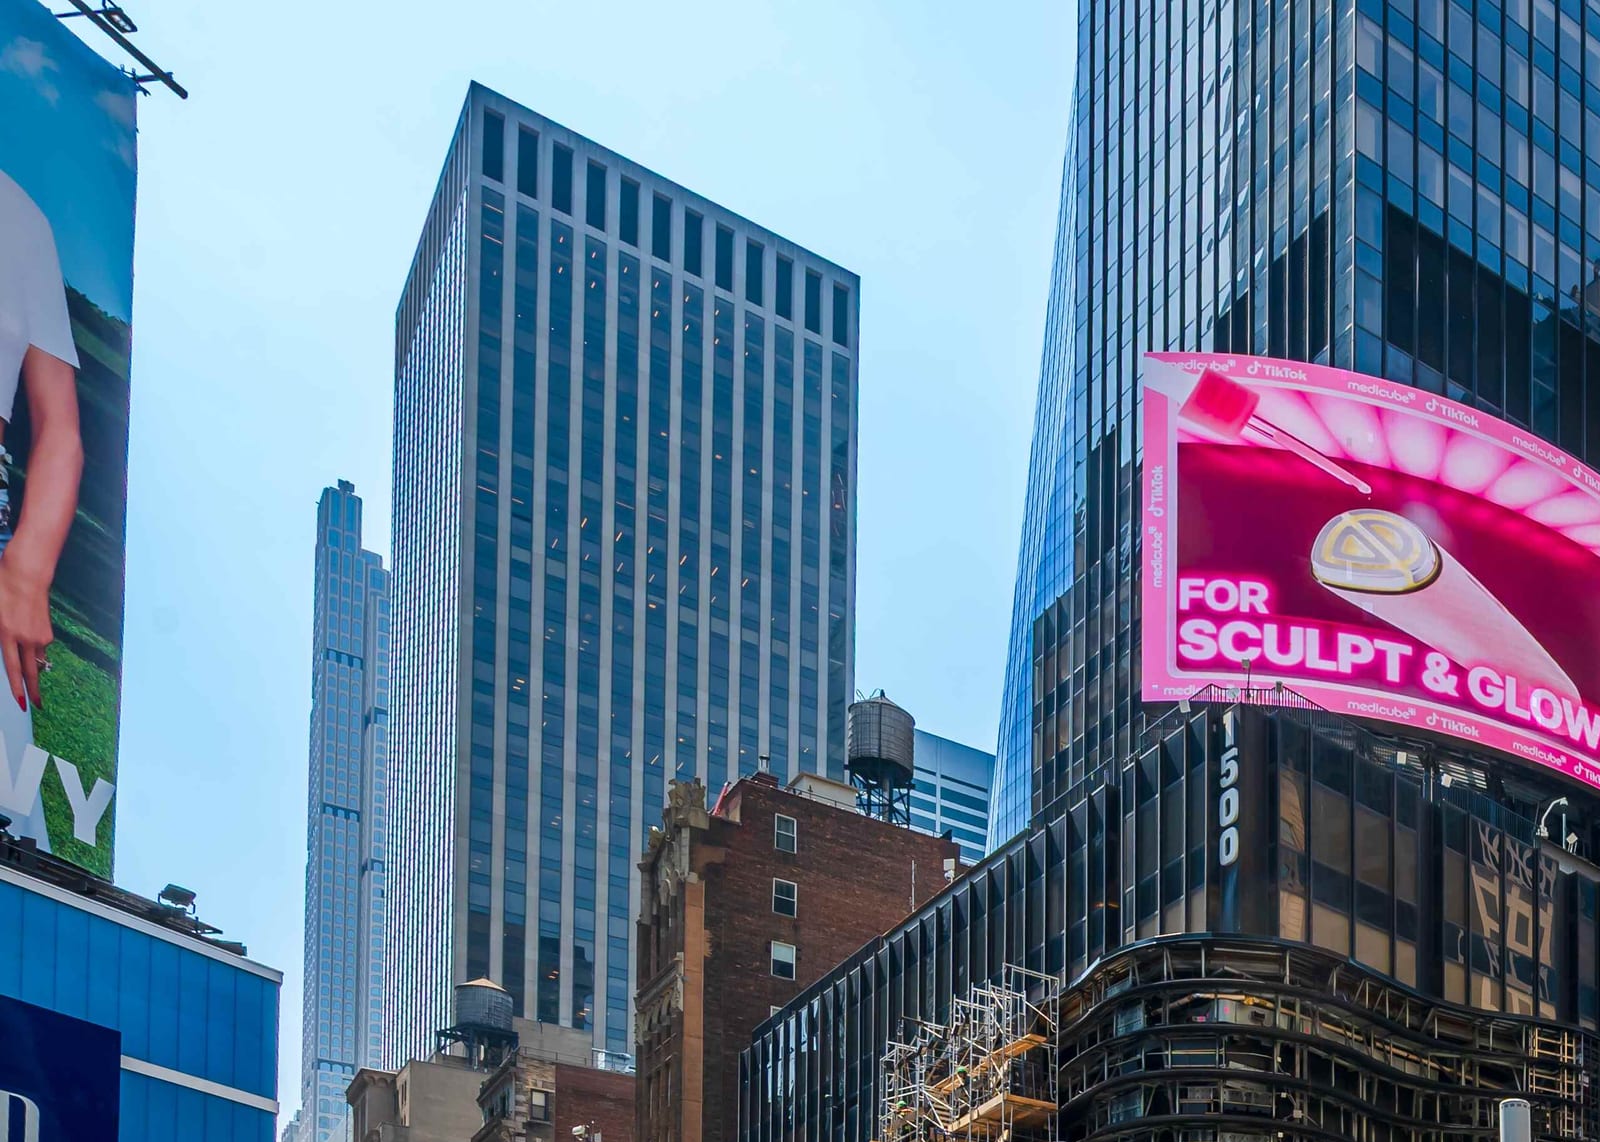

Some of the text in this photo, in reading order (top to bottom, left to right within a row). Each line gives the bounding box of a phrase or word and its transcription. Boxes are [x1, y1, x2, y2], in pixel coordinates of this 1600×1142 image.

[1264, 366, 1308, 382] TikTok
[1348, 380, 1480, 429] medicube TikTok
[1513, 435, 1562, 467] medicube
[1151, 465, 1163, 502] TikTok
[1179, 578, 1270, 615] FOR
[1178, 618, 1413, 683] SCULPT
[1422, 652, 1460, 698] &
[1348, 700, 1480, 737] medicube TikTok
[1513, 741, 1562, 767] medicube
[1219, 711, 1240, 866] 1500
